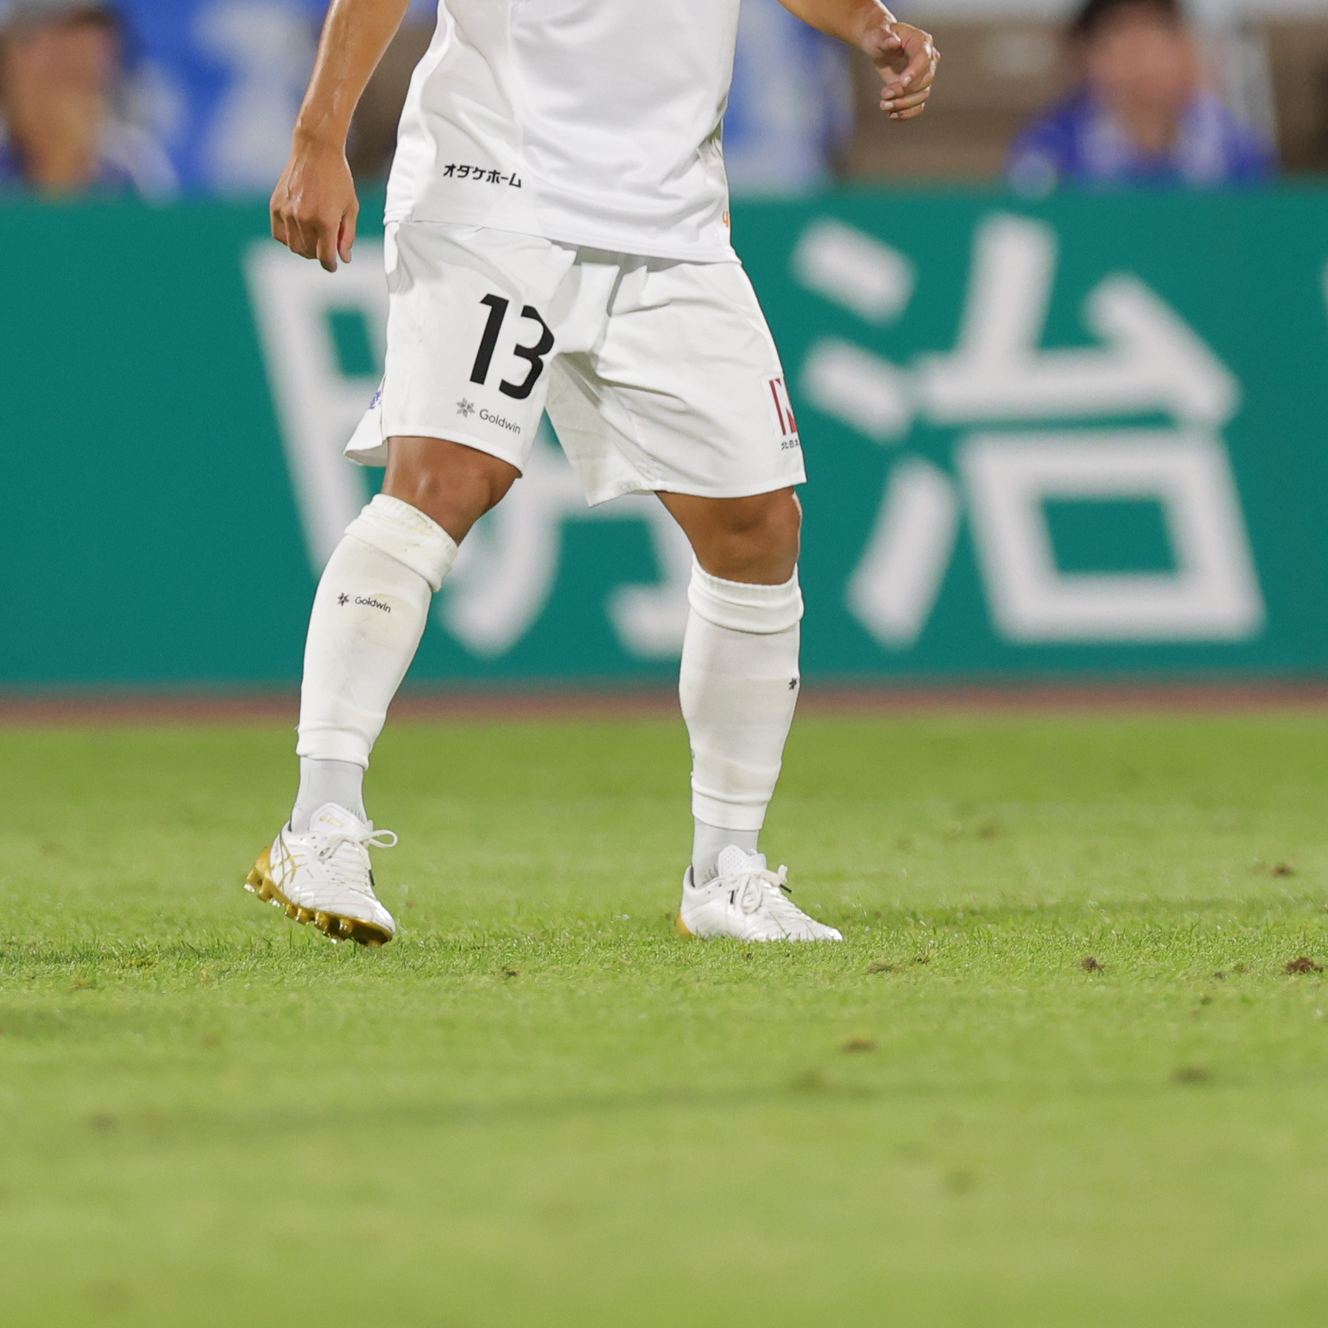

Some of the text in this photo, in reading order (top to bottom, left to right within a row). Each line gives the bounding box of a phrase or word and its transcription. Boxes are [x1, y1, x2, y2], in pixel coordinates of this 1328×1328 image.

[443, 163, 522, 189] オダケホーム
[469, 293, 555, 400] 13
[478, 408, 522, 435] Goldwin
[354, 596, 391, 613] Goldwin
